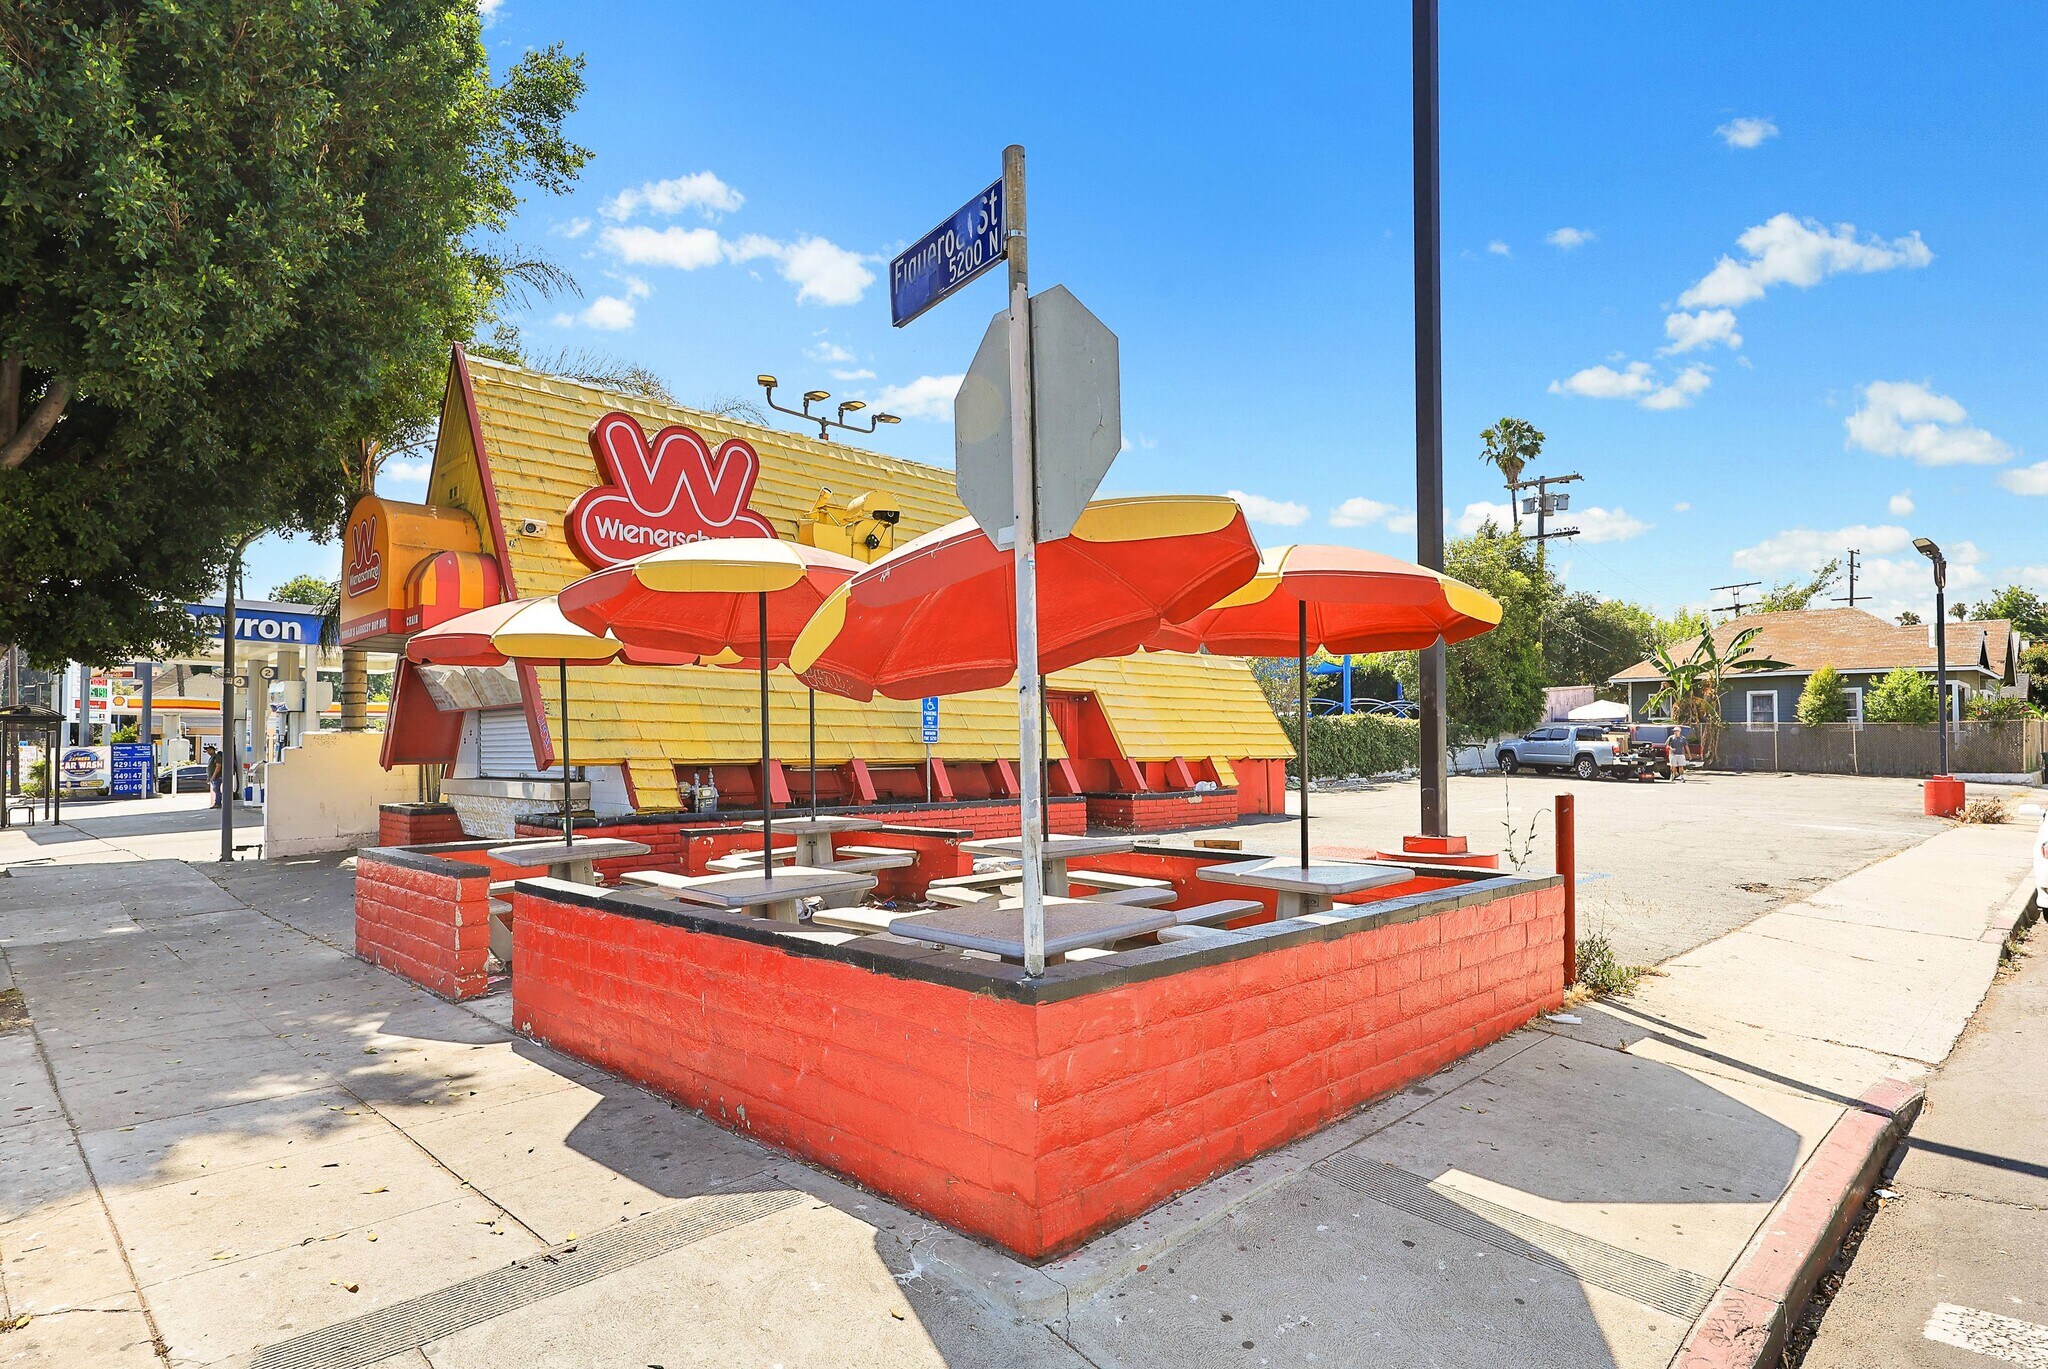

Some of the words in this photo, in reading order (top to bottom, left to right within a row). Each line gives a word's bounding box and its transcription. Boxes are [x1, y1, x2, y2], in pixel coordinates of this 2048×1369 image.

[977, 189, 998, 235] St
[949, 239, 982, 283] 5200
[989, 228, 998, 256] N
[406, 614, 419, 626] CHAIN
[78, 761, 103, 769] WASH
